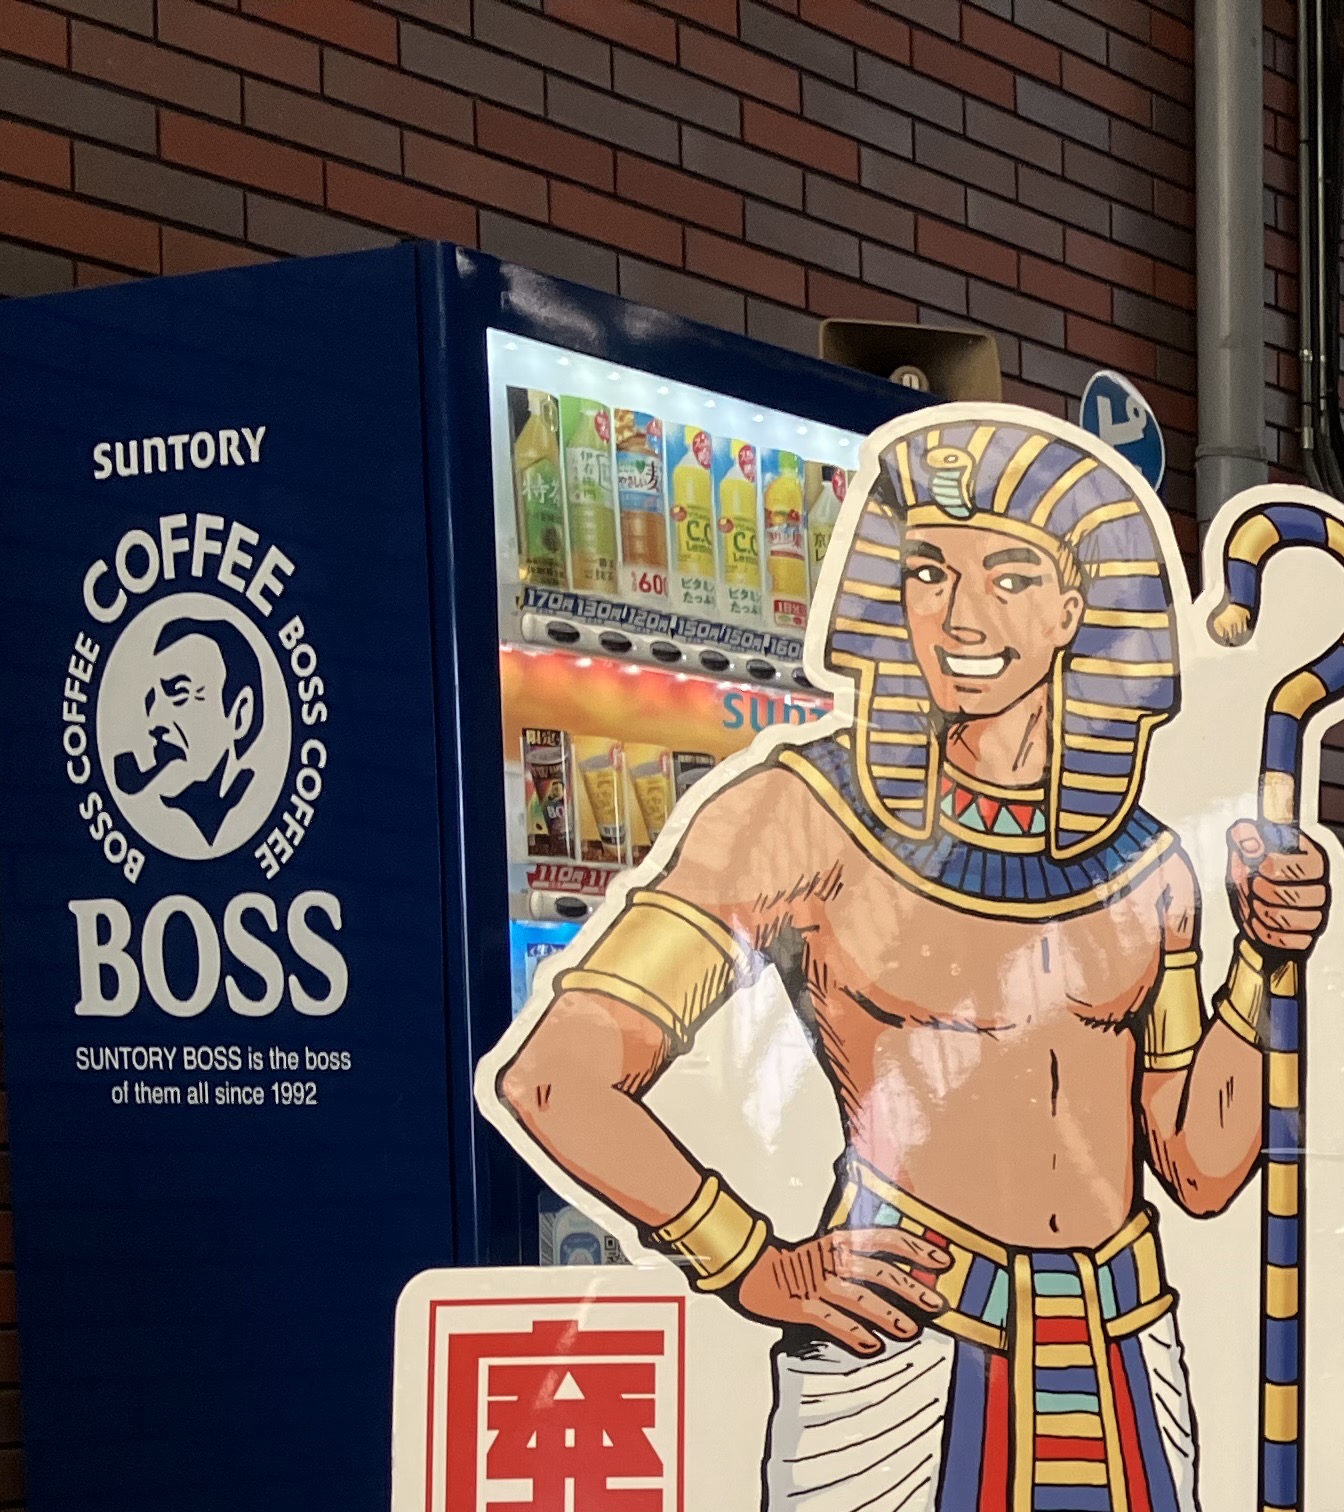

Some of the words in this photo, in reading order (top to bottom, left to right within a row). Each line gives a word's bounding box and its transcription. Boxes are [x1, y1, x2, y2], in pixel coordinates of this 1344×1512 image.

[93, 425, 267, 480] SUNTORY
[83, 512, 295, 623] COFFEE
[62, 630, 100, 785] COFFEE
[278, 614, 327, 726] BOSS
[79, 791, 146, 884] BOSS
[254, 738, 327, 880] COFFEE
[67, 890, 349, 1017] BOSS
[76, 1046, 177, 1071] SUNTORY
[183, 1045, 242, 1071] BOSS
[247, 1046, 264, 1071] is
[268, 1045, 300, 1071] the
[304, 1045, 352, 1071] boss
[111, 1080, 131, 1104] of
[134, 1080, 181, 1105] them
[187, 1081, 209, 1105] all
[215, 1081, 265, 1105] since
[270, 1081, 319, 1105] 1992
